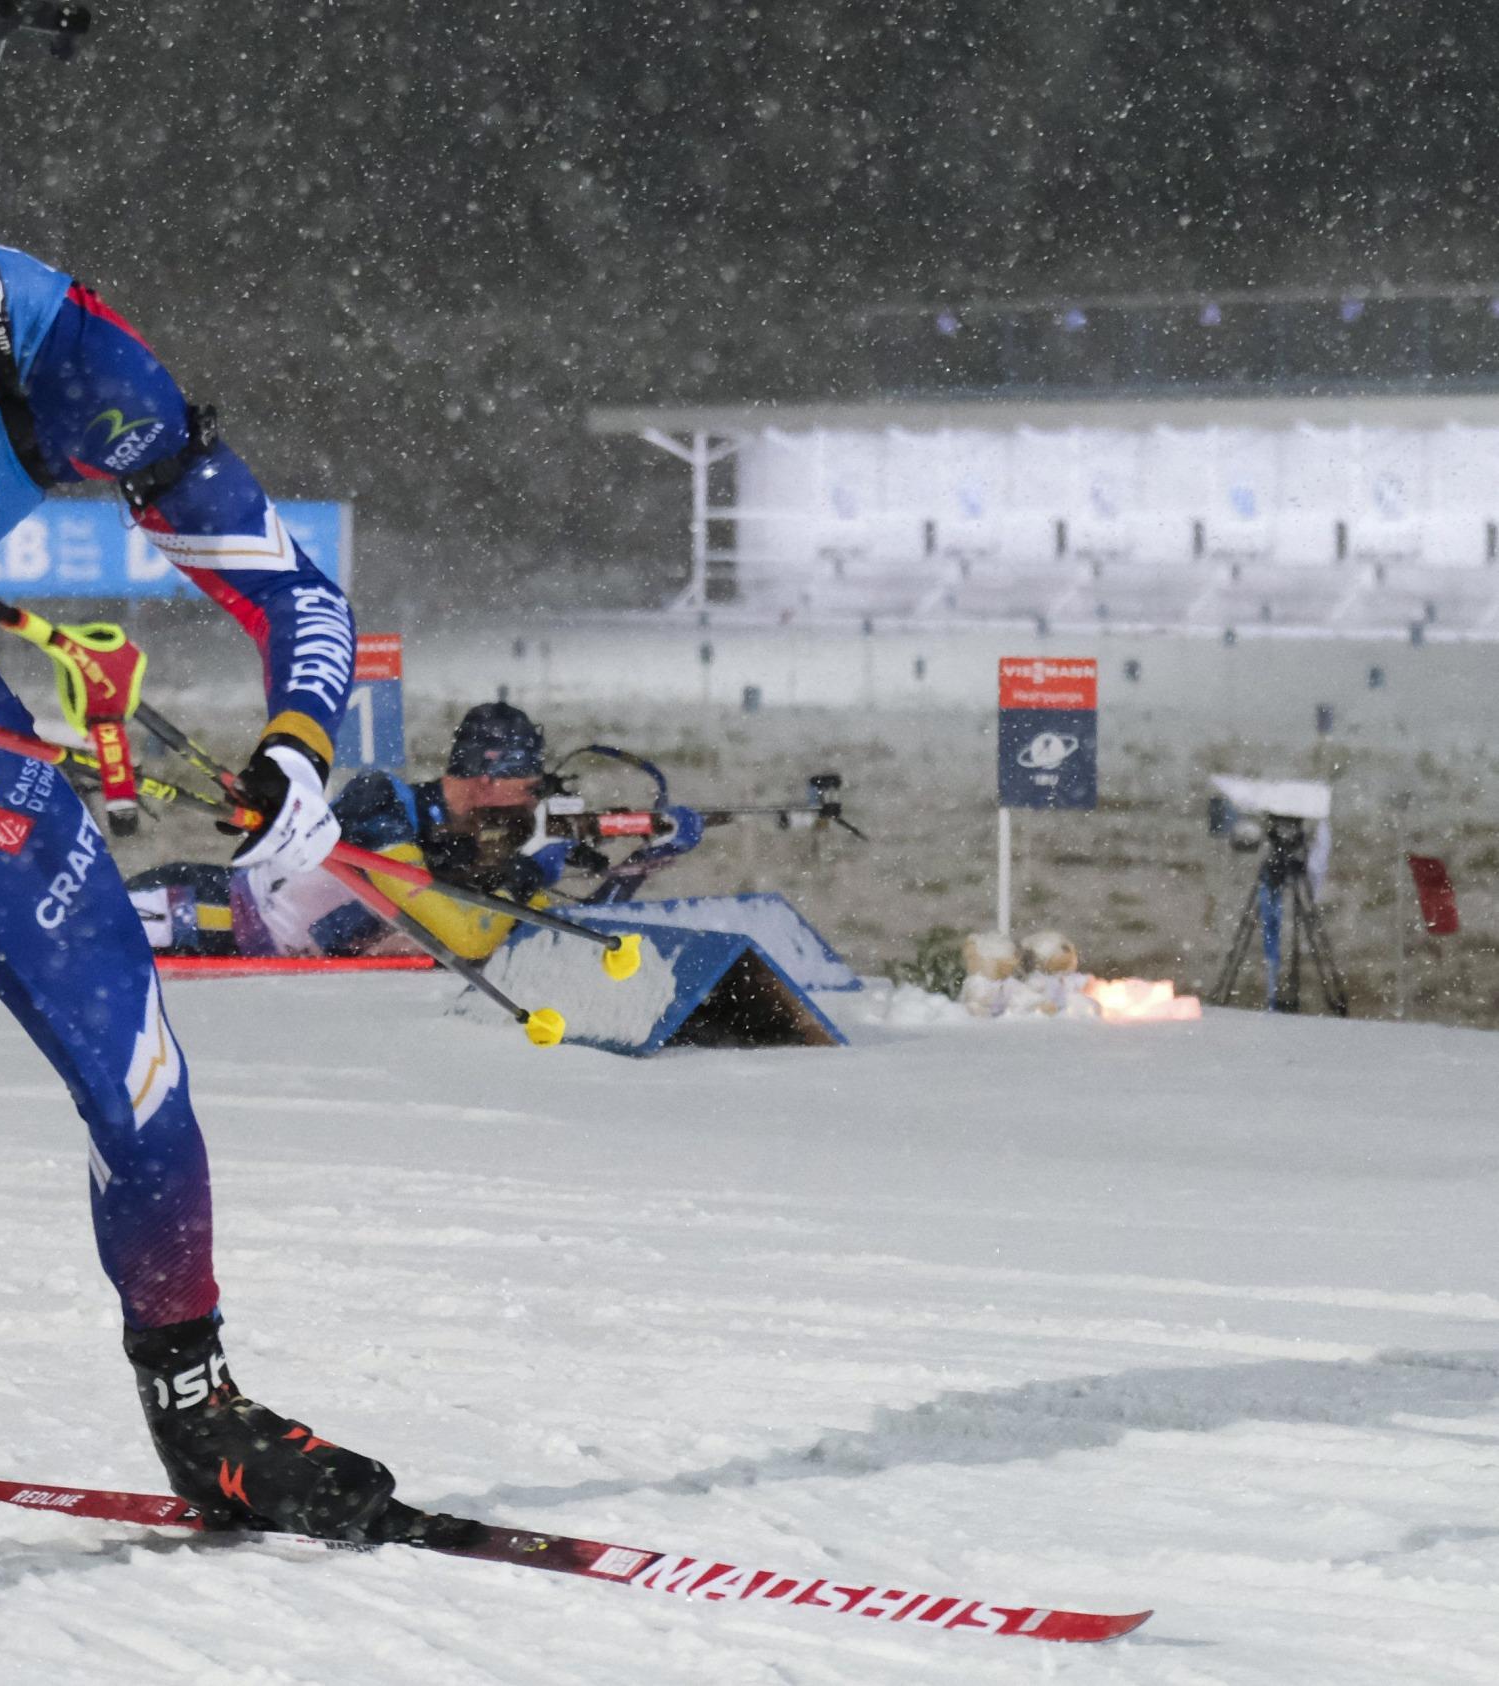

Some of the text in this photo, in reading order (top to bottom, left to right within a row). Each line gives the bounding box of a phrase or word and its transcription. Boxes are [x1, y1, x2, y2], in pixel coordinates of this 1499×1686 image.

[287, 586, 353, 713] FRANCE
[98, 721, 126, 784] LEKI
[346, 685, 374, 765] 1
[35, 800, 104, 930] CRAFT
[10, 1490, 85, 1508] REDLINE
[631, 1554, 1019, 1635] MADSHUS
